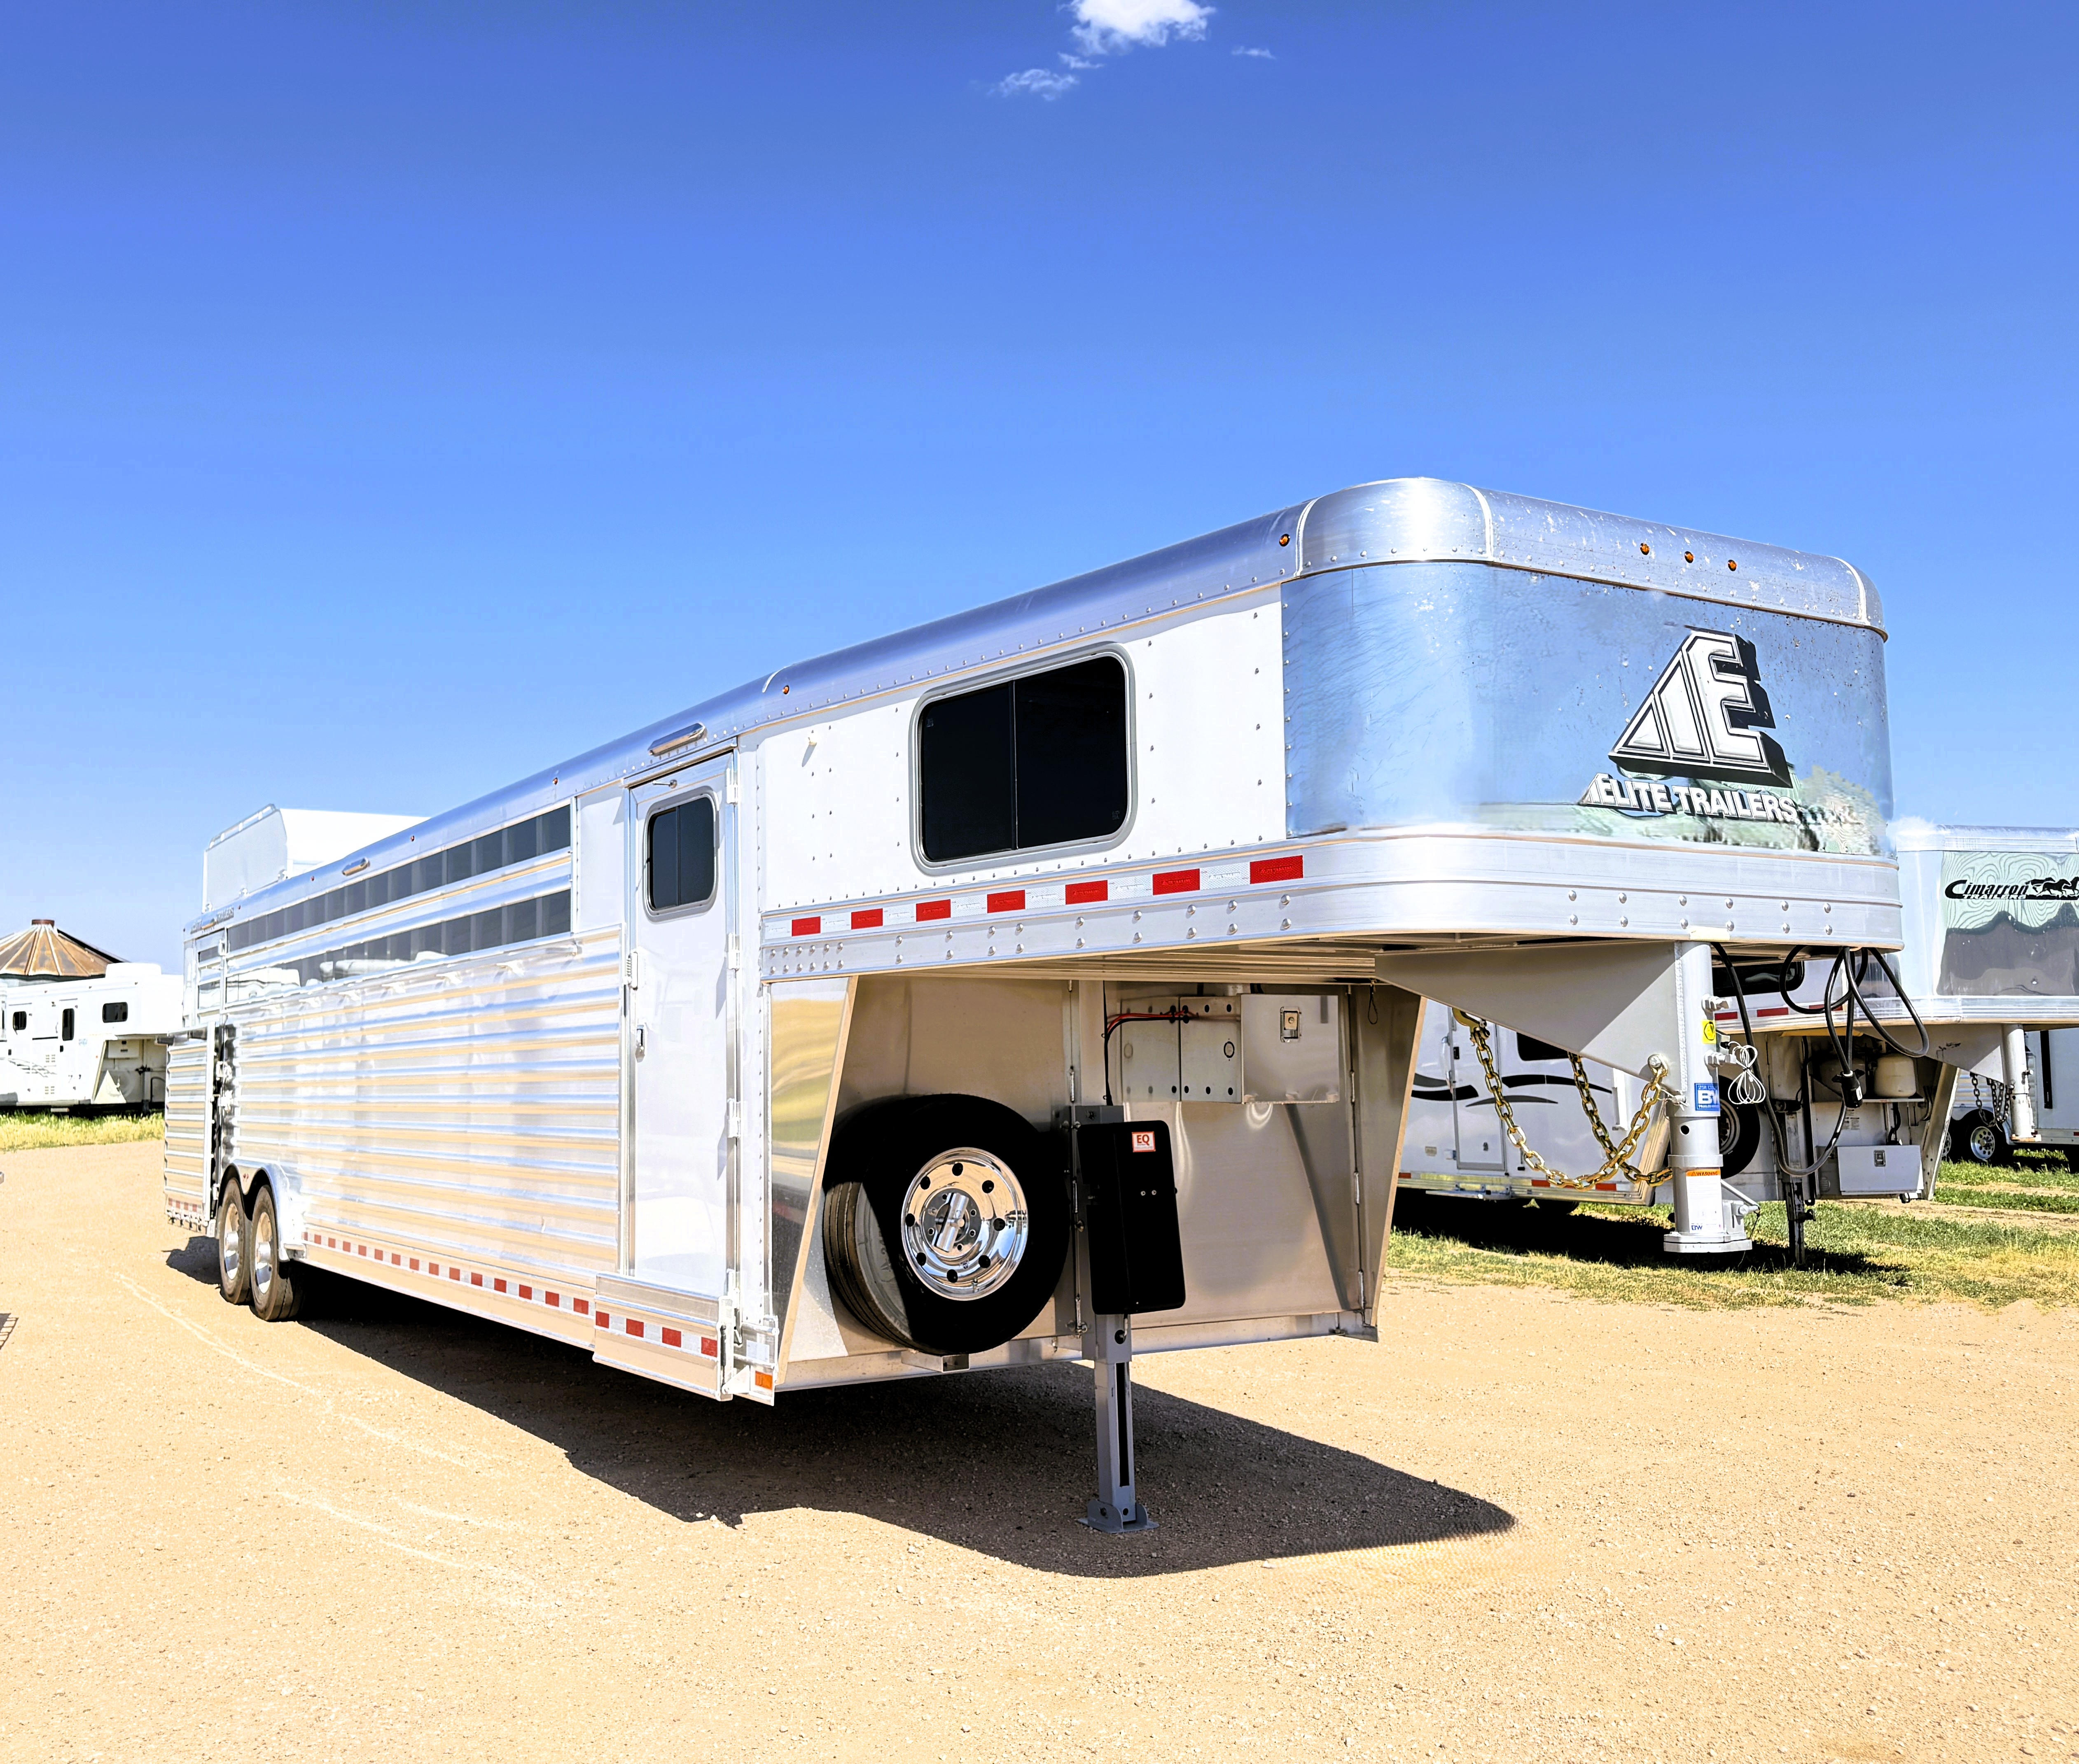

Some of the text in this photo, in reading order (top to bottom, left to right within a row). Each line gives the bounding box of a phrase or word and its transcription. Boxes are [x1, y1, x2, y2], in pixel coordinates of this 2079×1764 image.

[1586, 773, 1799, 823] ELITE TRAILERS
[1945, 880, 2029, 899] Cimarron
[1137, 1134, 1150, 1146] EQ
